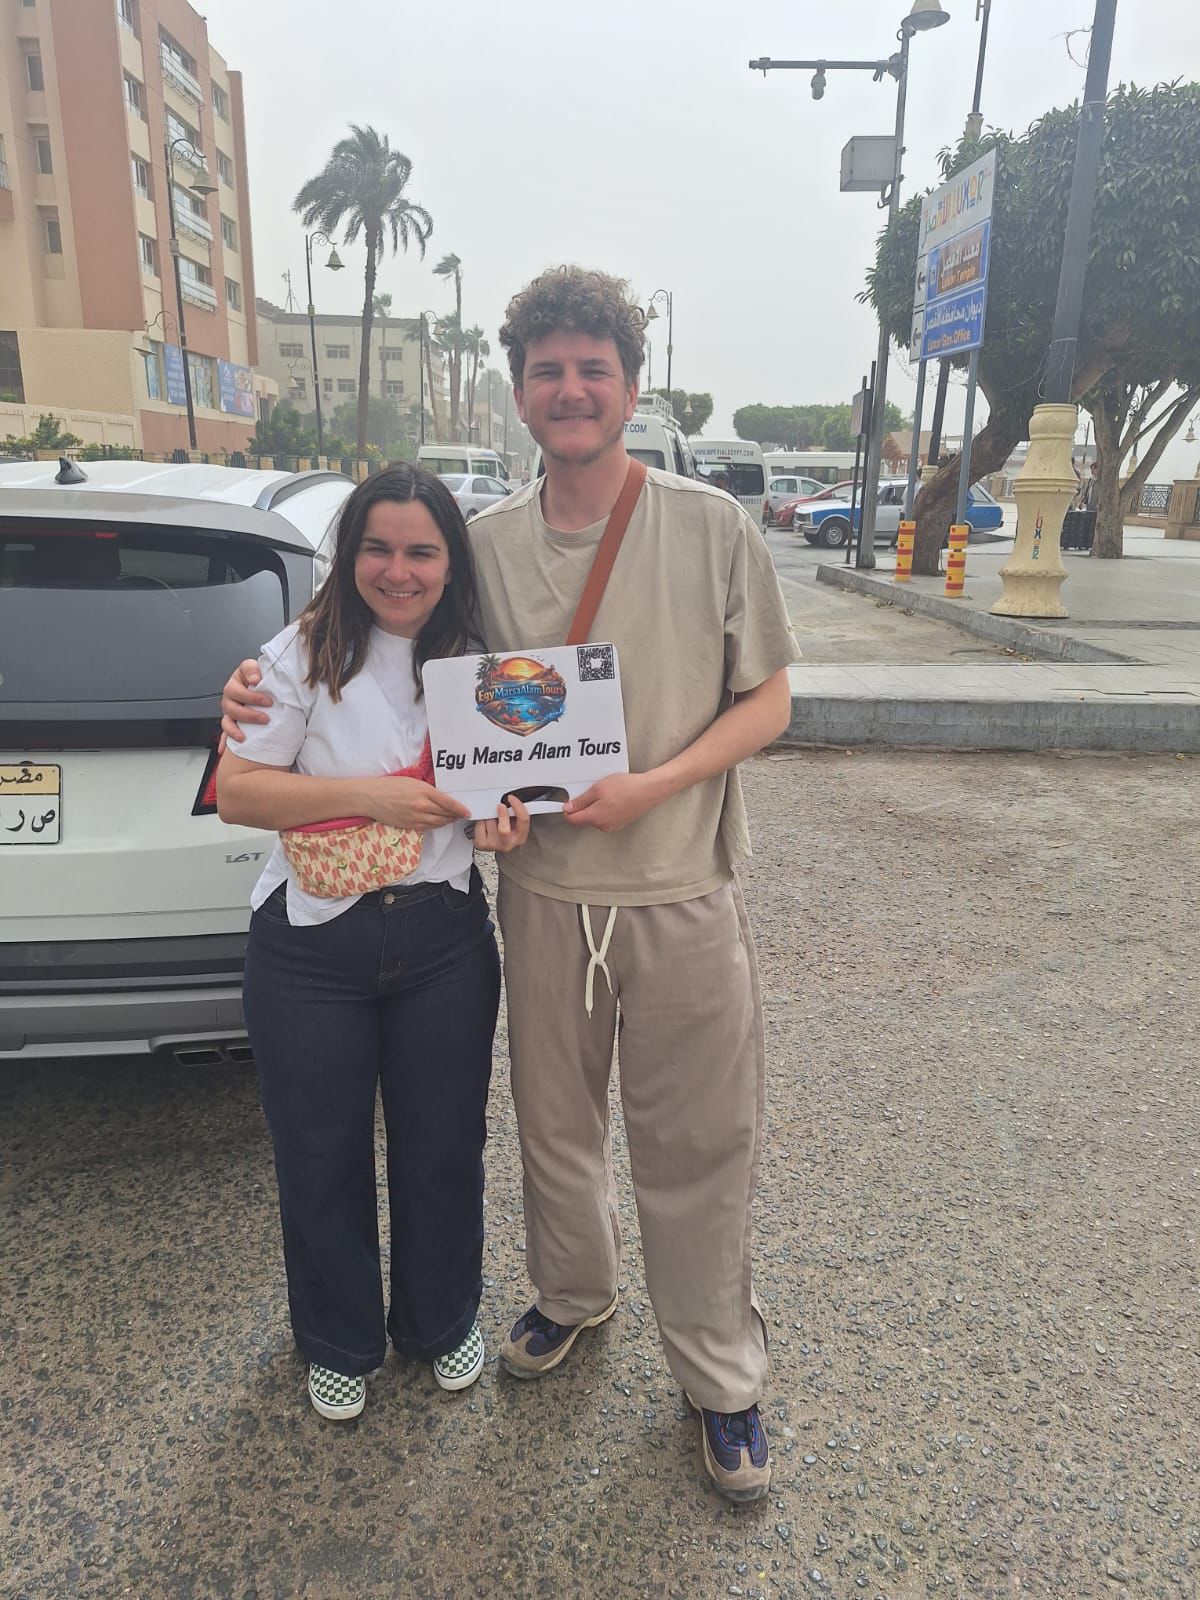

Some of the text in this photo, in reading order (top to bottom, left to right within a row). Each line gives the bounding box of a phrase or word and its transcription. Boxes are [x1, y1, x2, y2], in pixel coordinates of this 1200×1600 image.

[957, 264, 976, 283] Temple
[436, 738, 621, 770] Egy Marsa Alam Tours
